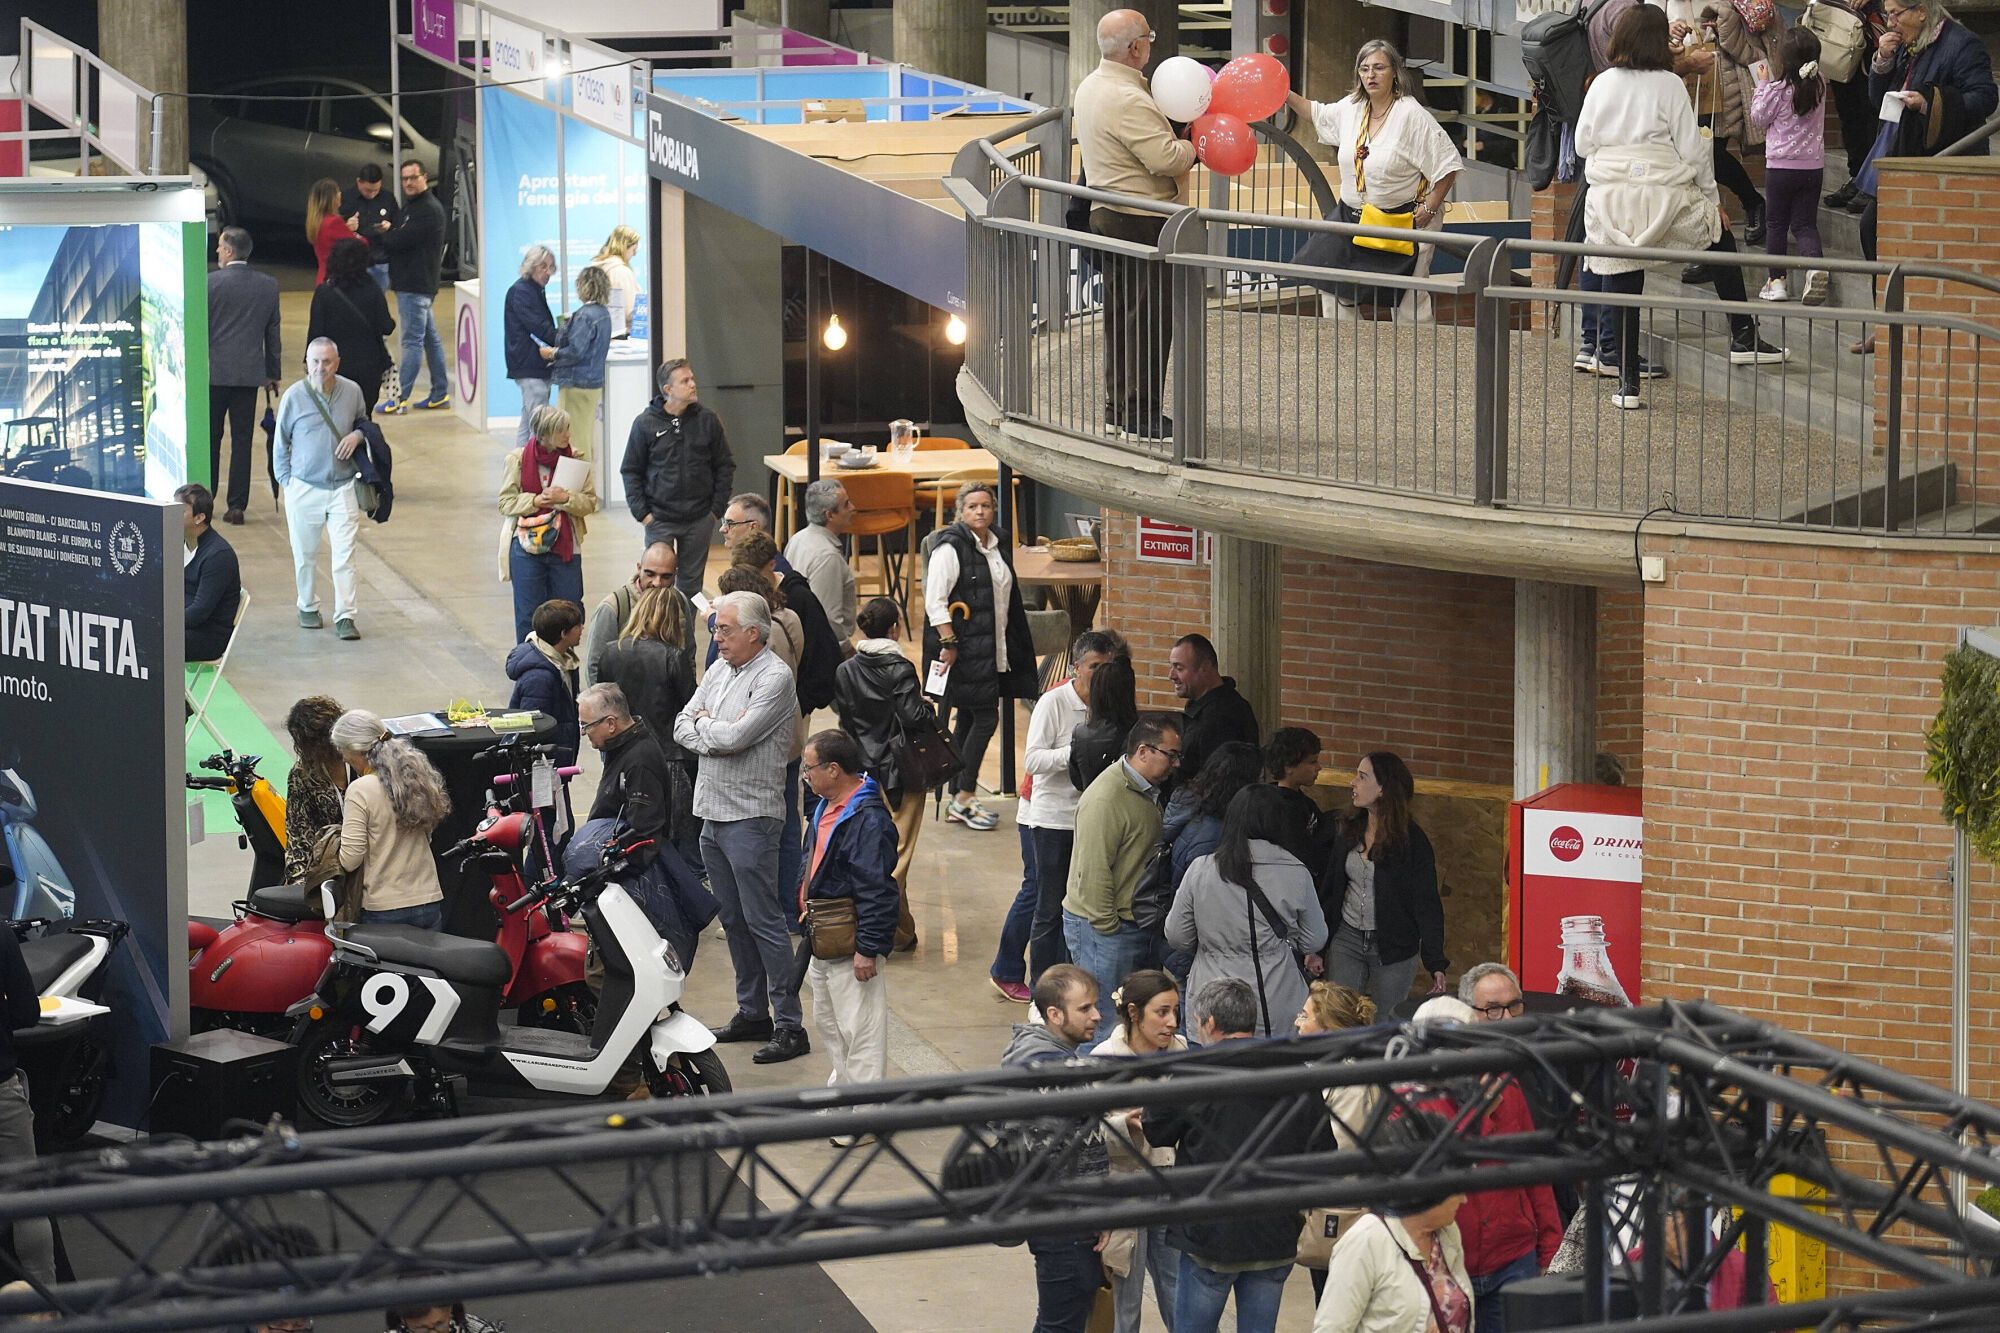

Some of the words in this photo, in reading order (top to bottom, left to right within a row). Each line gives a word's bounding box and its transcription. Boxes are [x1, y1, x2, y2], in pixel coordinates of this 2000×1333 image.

[495, 40, 520, 70] endesa
[577, 73, 604, 105] endesa
[653, 131, 700, 180] MOBALPA
[0, 508, 25, 521] LANMOTO
[26, 512, 46, 524] GIRONA
[91, 521, 101, 533] 151
[7, 526, 36, 539] BLANMOTO
[36, 530, 56, 543] BLANES
[94, 540, 101, 550] 45
[1143, 540, 1189, 553] EXTINTOR
[8, 543, 16, 553] DE
[16, 545, 43, 558] SALVADOR
[91, 556, 102, 567] 102
[0, 598, 50, 662] TAT
[59, 608, 149, 680] NETA.
[0, 675, 53, 702] moto.
[1593, 836, 1642, 850] DRINK
